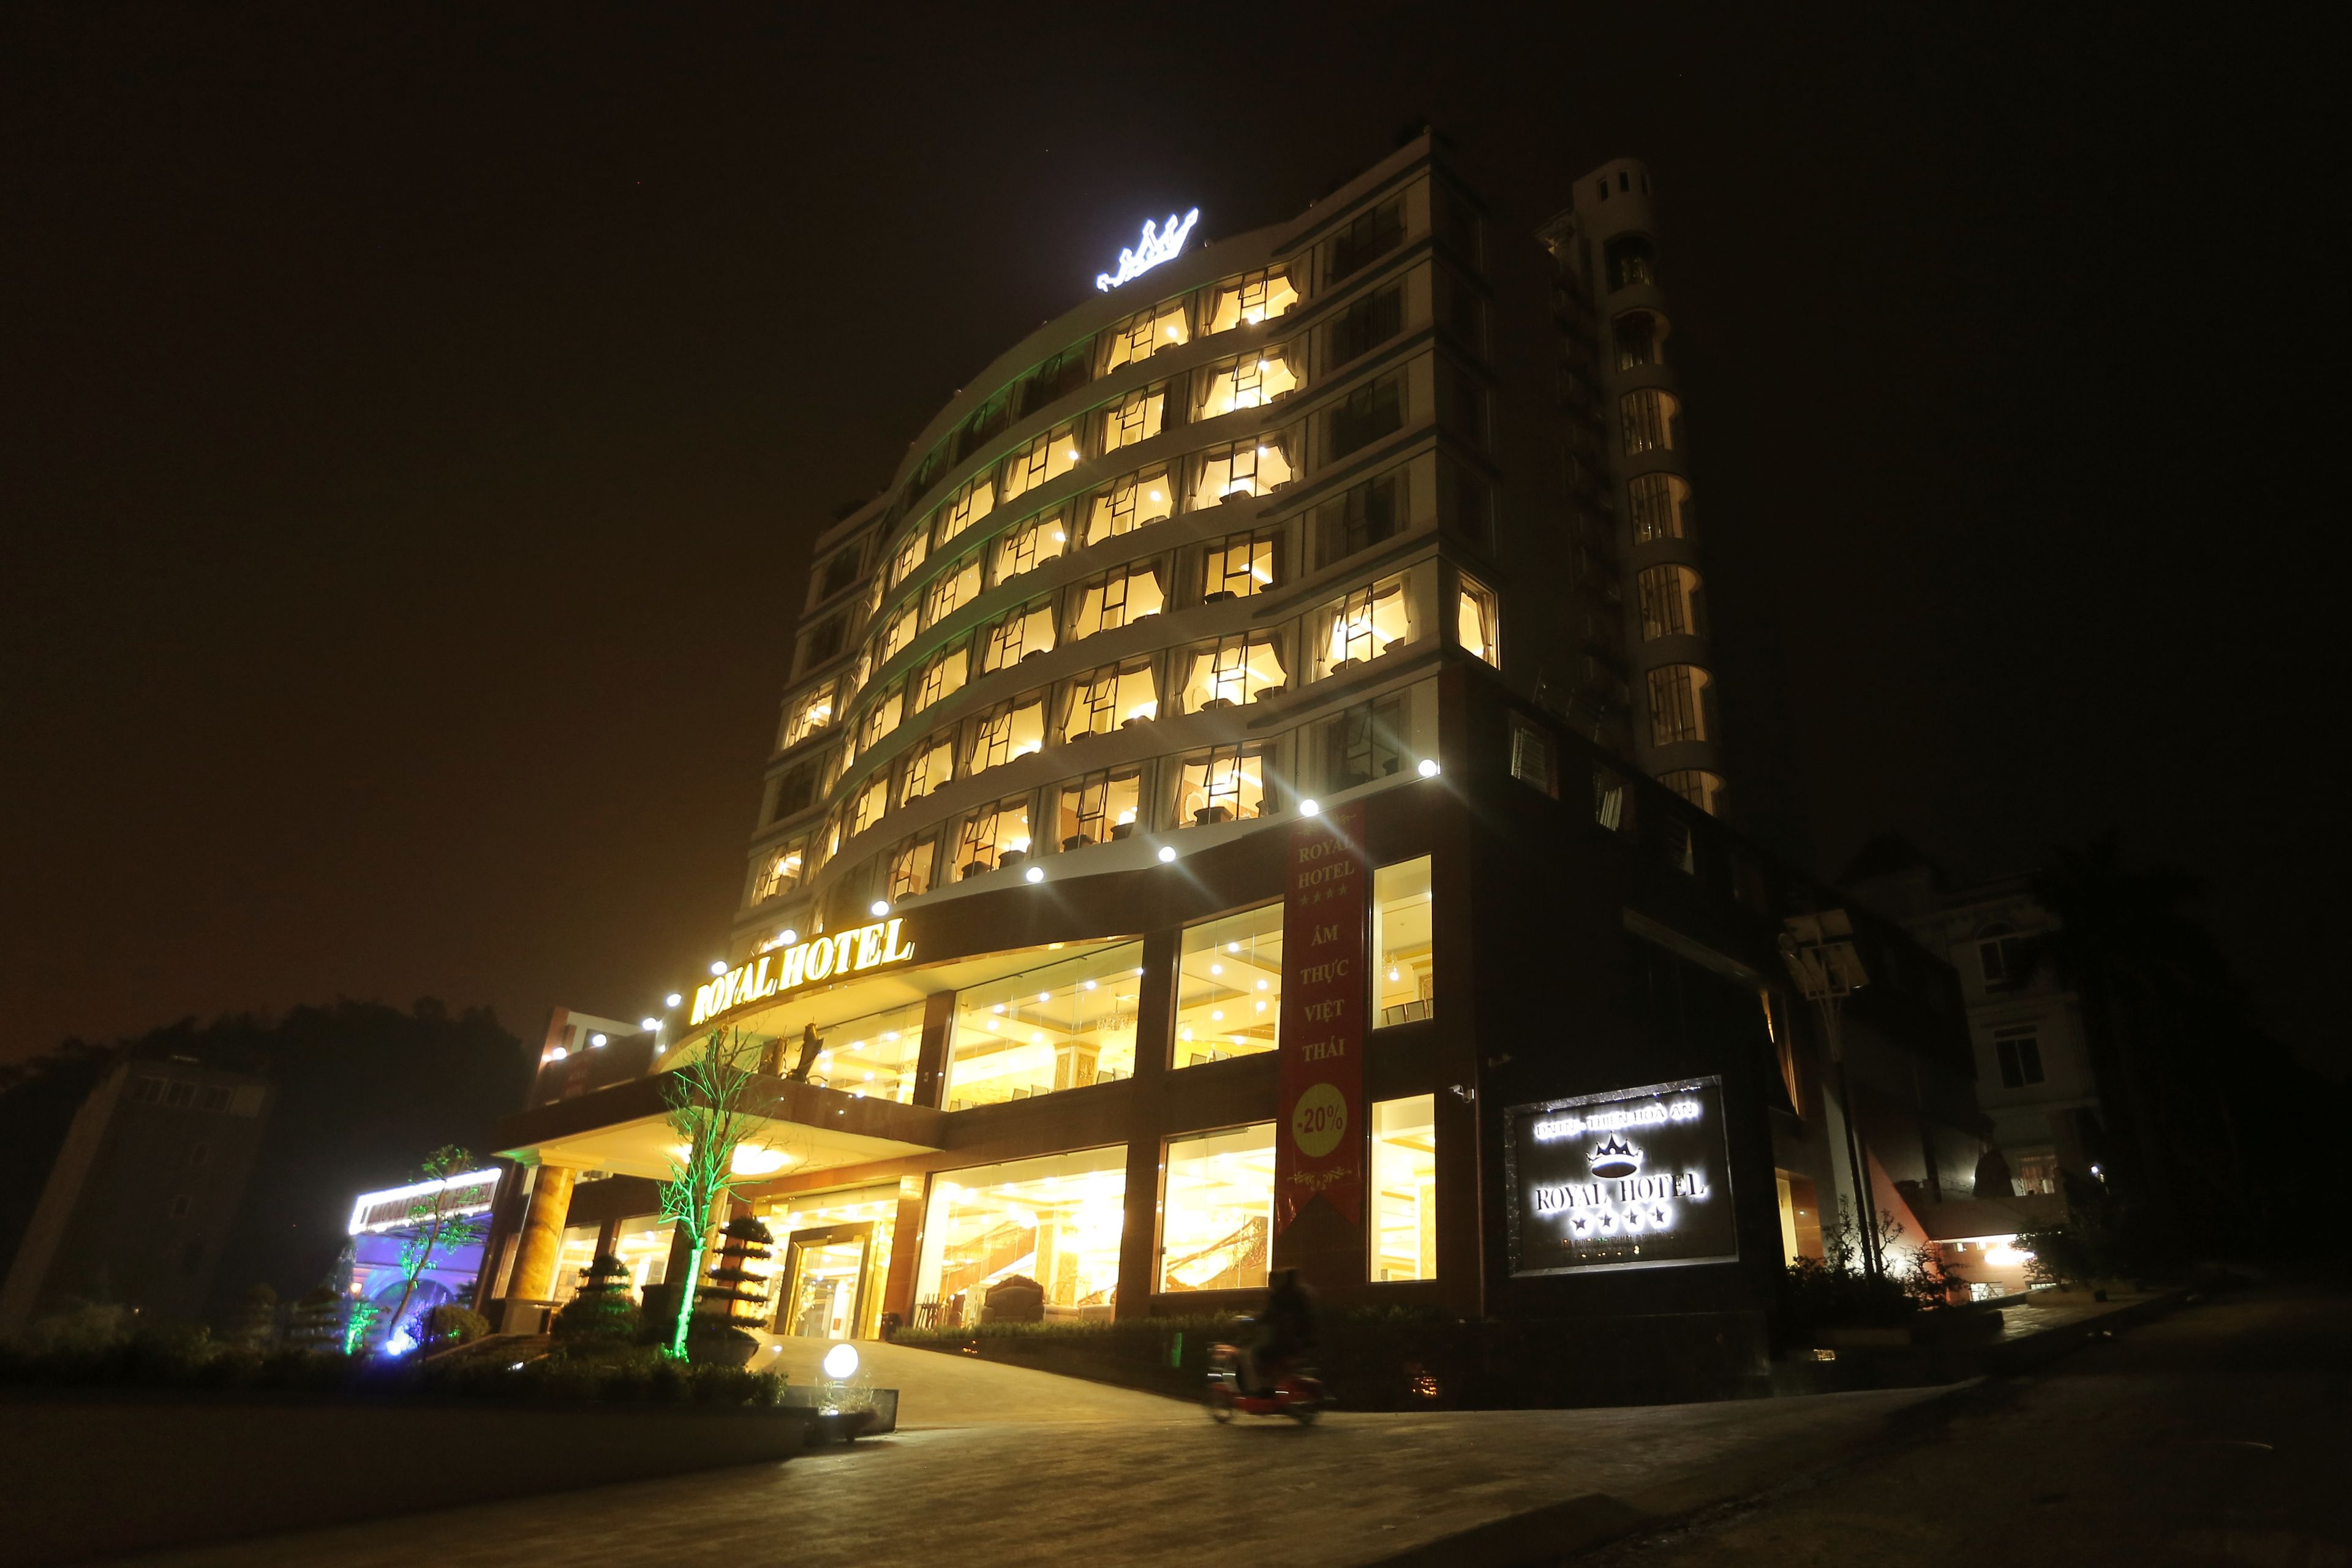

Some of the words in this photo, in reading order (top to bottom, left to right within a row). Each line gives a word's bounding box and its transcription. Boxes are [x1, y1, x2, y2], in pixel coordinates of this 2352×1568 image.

[1298, 835, 1354, 862] ROYAL
[1298, 861, 1354, 888] HOTEL
[690, 956, 778, 1027] ROYAL
[777, 918, 916, 991] HOTEL
[1300, 959, 1348, 985] THỰC
[1304, 999, 1345, 1023] VIỆT
[1302, 1035, 1345, 1062] THÁI
[1297, 1104, 1343, 1134] -20%
[1536, 1183, 1611, 1210] ROYAL
[1619, 1173, 1708, 1202] HOTEL
